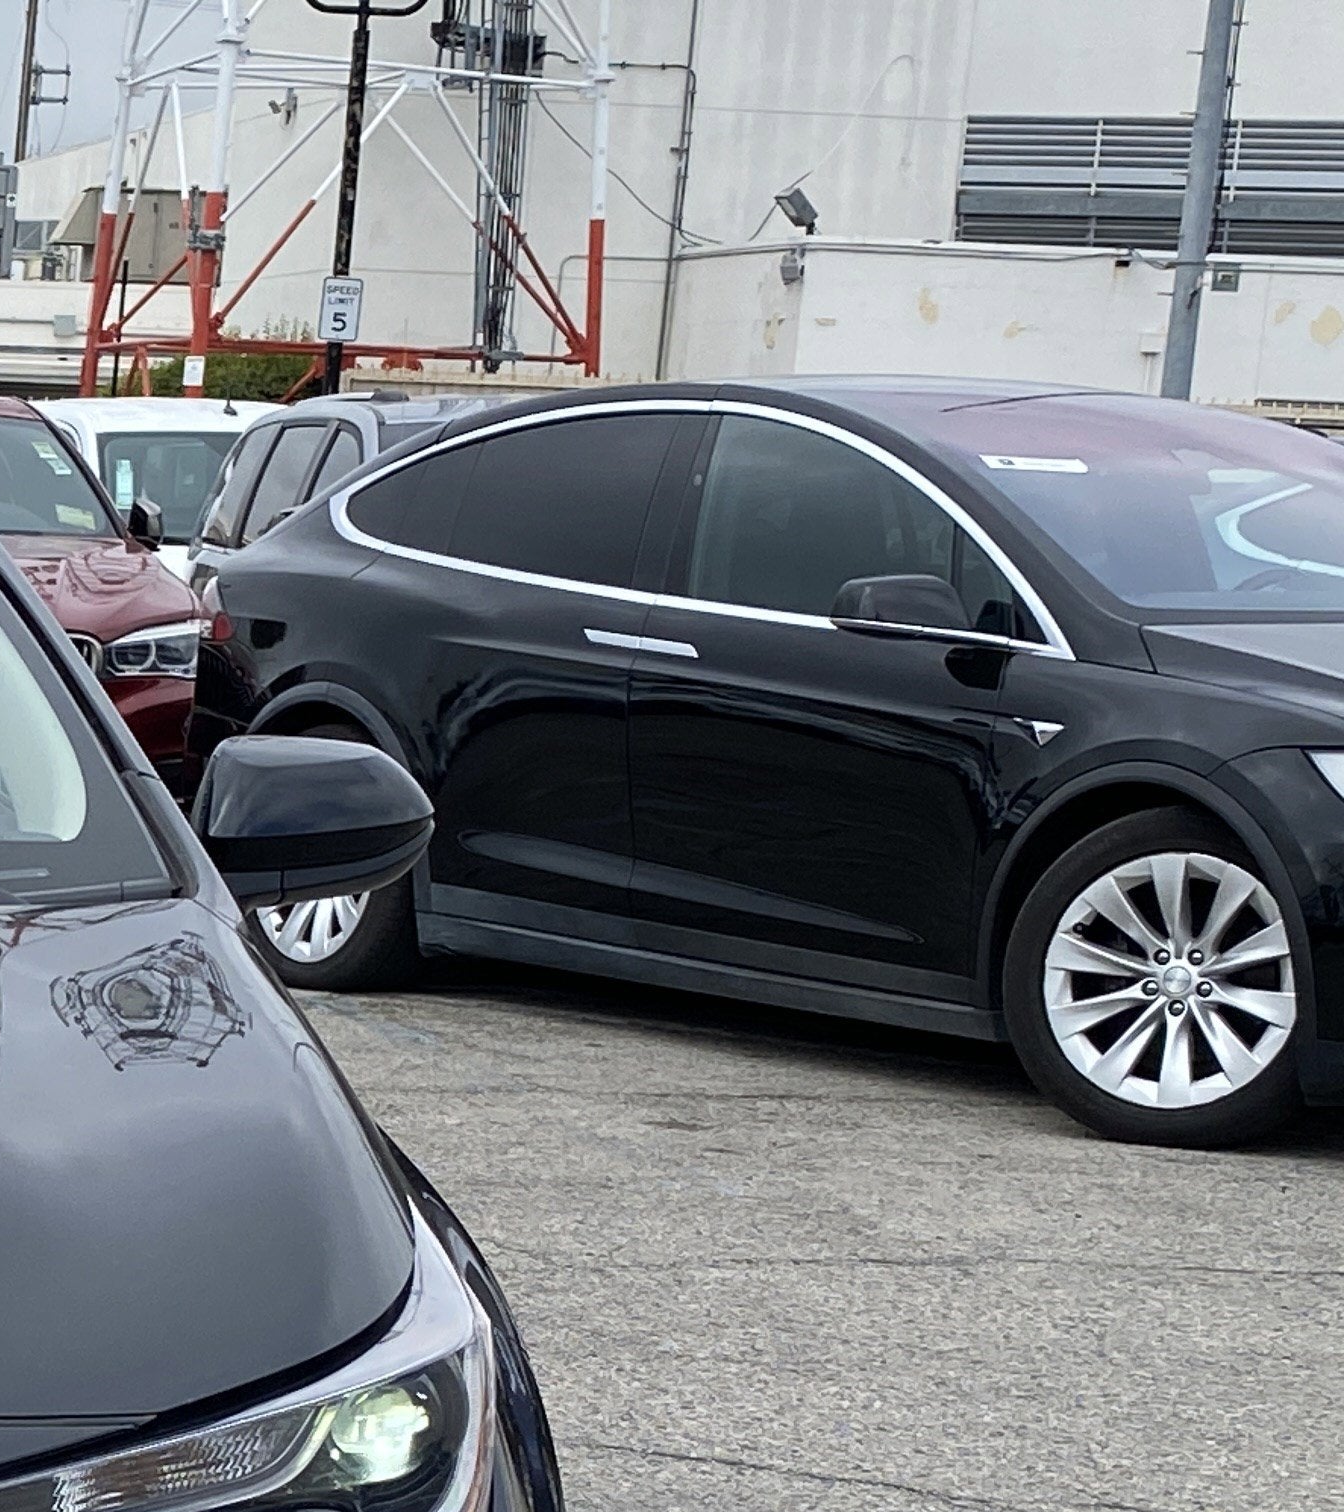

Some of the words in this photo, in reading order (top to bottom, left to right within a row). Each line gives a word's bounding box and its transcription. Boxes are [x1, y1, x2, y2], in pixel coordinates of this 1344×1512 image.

[327, 285, 360, 295] SPEED
[327, 297, 355, 305] LIMIT
[331, 312, 347, 332] 5
